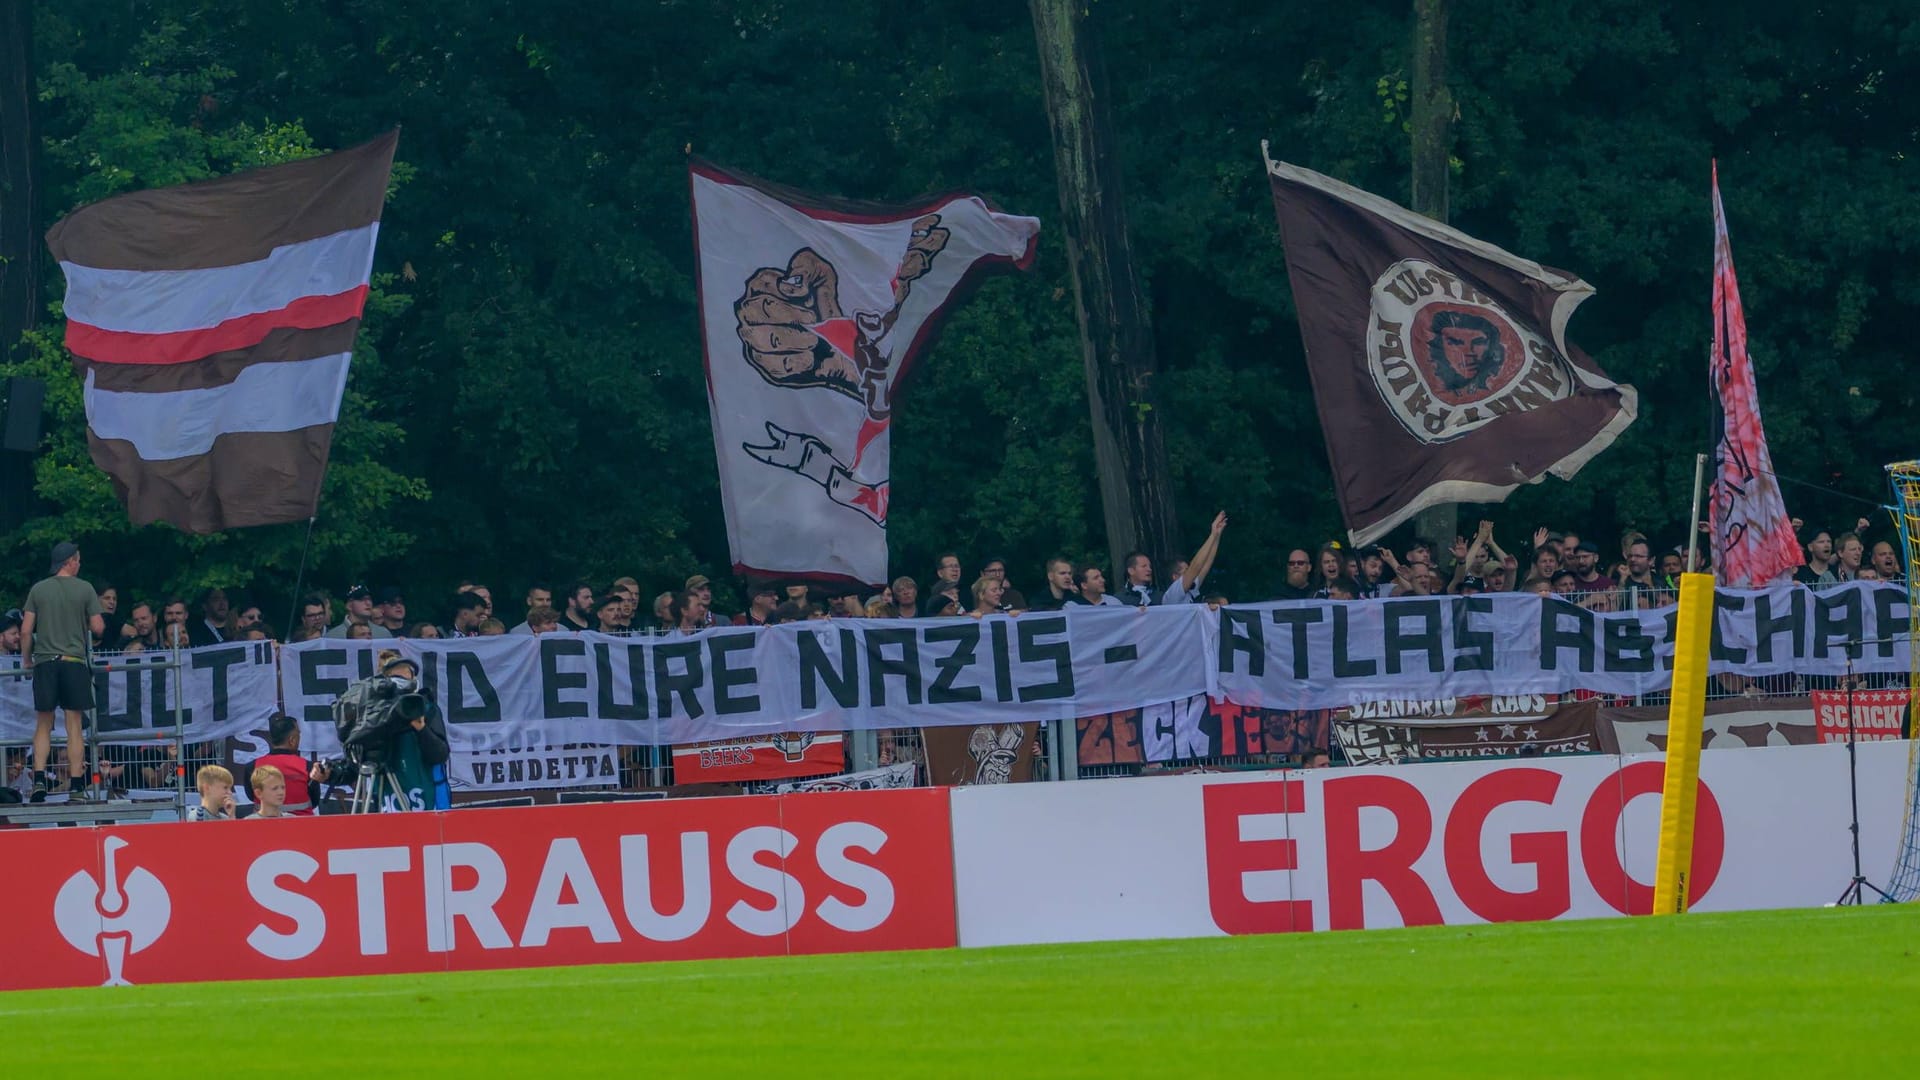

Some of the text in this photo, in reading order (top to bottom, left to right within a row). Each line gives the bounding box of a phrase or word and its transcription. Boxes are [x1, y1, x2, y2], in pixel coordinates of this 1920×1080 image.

[1378, 317, 1451, 434] PAULI
[300, 648, 501, 723] SD
[541, 632, 761, 720] EURE
[798, 616, 1075, 709] NAZIS
[1218, 596, 1495, 679] ATLAS
[472, 754, 615, 785] VENDETTA
[700, 745, 755, 769] BEERS
[246, 821, 896, 961] STRAUSS
[1202, 761, 1725, 935] ERGO
